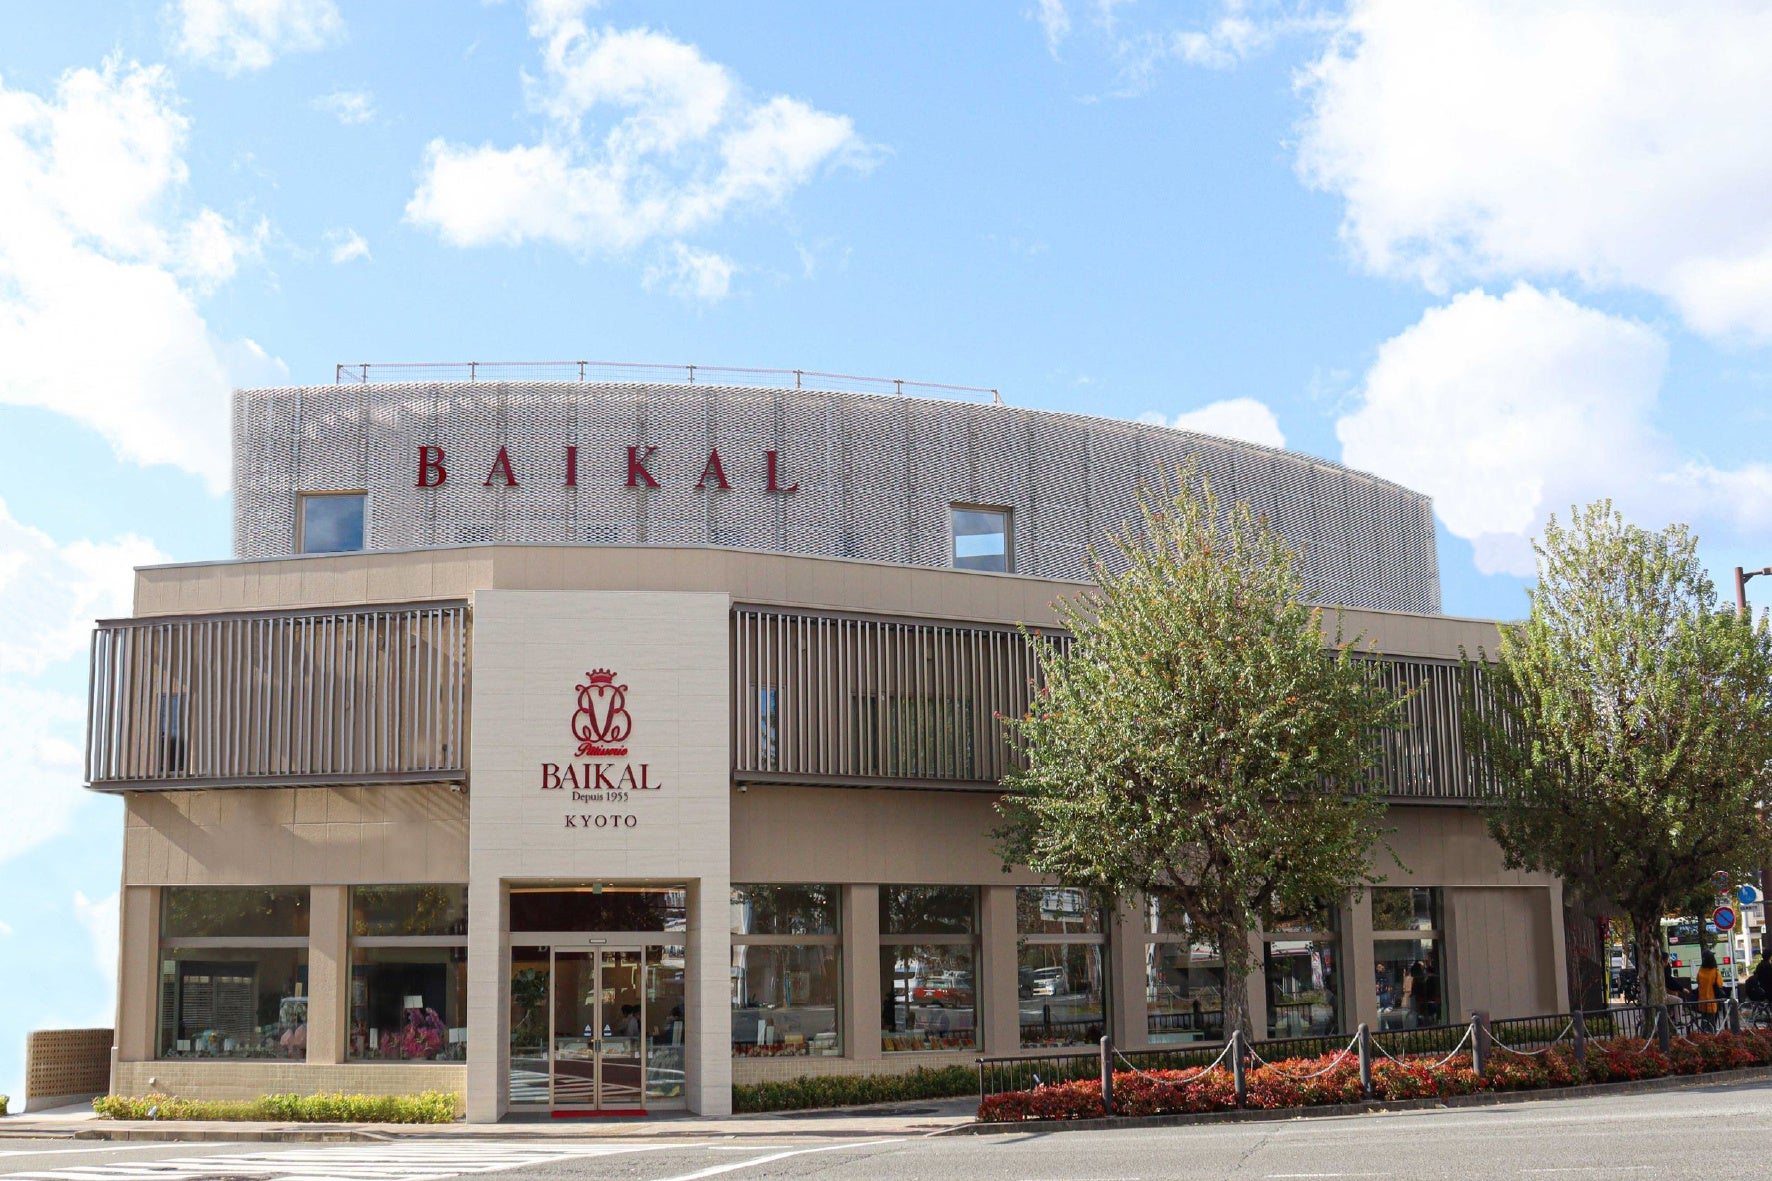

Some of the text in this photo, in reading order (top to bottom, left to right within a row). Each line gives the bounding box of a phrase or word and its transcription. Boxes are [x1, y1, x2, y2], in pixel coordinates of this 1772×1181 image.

[415, 445, 799, 493] BAIKAL
[540, 763, 662, 790] BAIKAL
[572, 791, 629, 803] Depuis 1955
[565, 814, 637, 828] KYOTO
